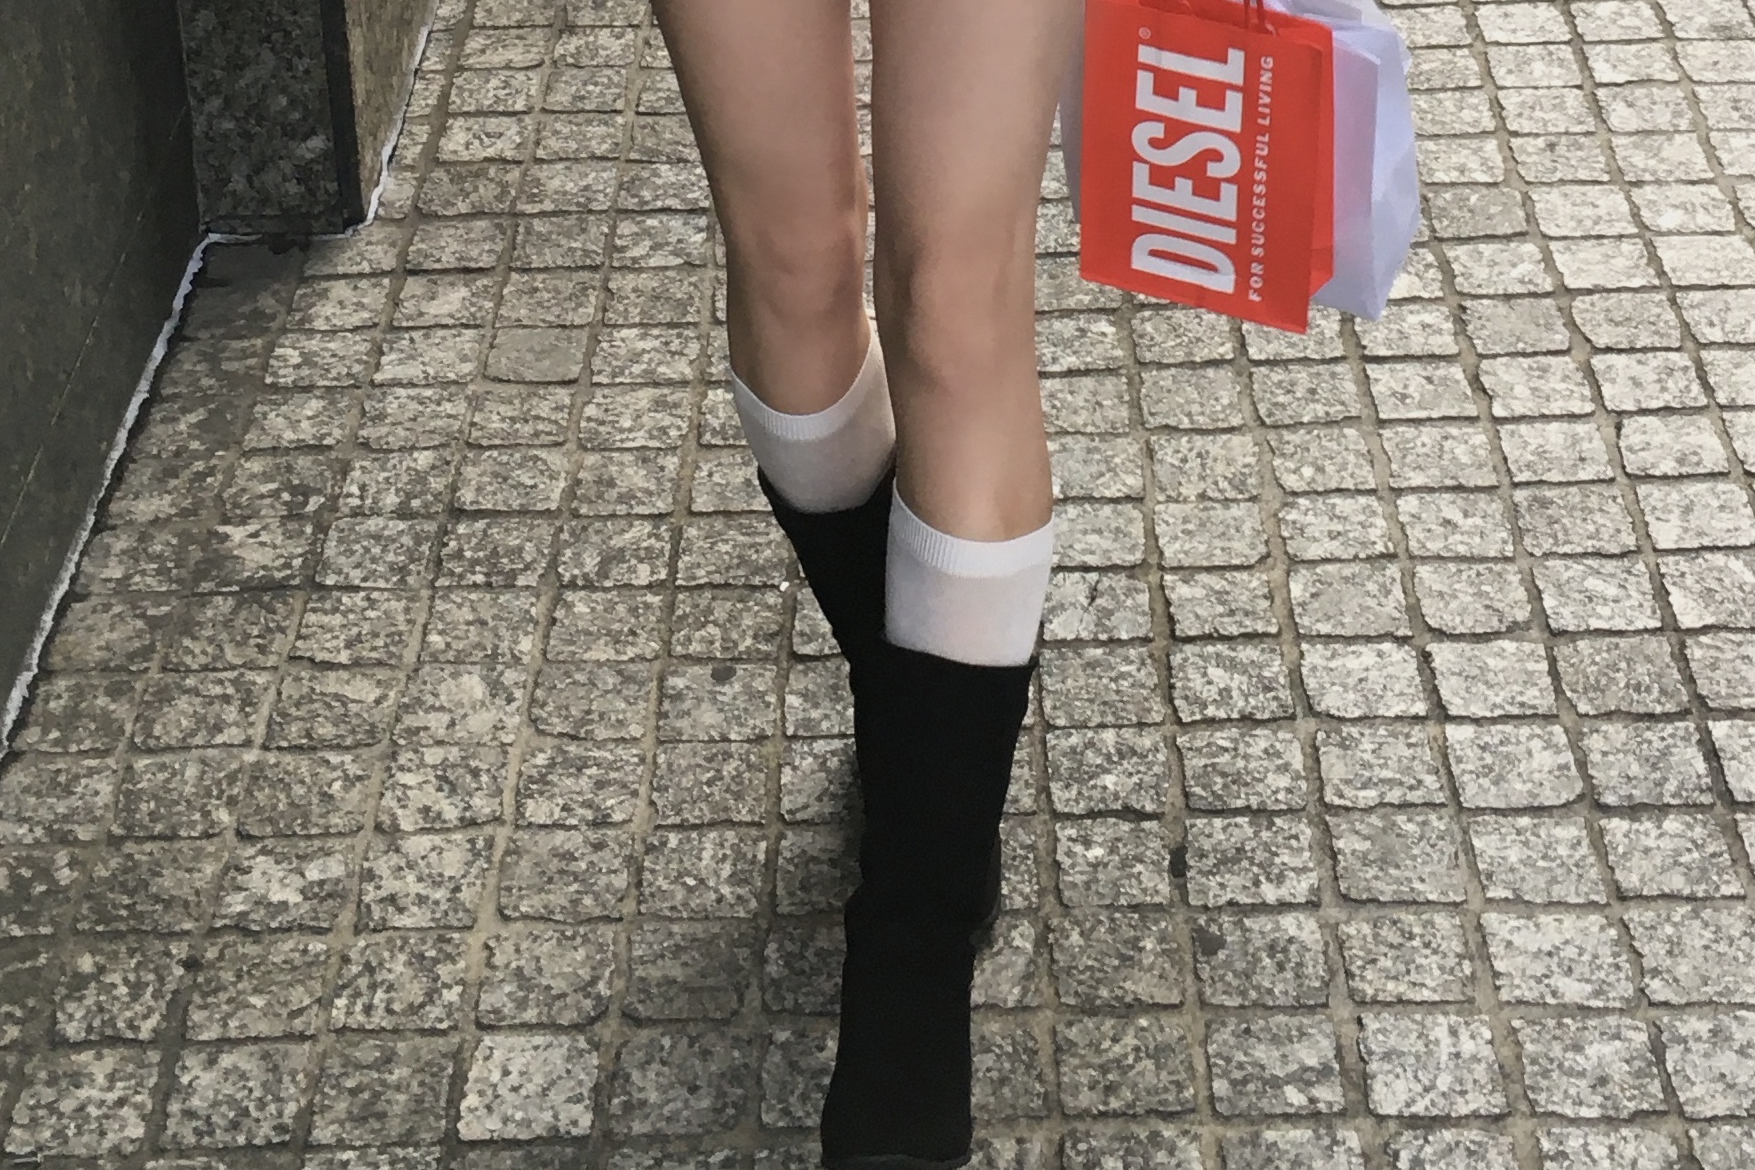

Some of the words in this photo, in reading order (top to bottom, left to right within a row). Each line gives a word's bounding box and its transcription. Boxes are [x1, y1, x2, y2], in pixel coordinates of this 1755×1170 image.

[1257, 56, 1273, 126] LIVING
[1131, 43, 1245, 294] DIESEL
[1251, 133, 1269, 258] SUCCESSFUL
[1248, 262, 1264, 302] FOR
